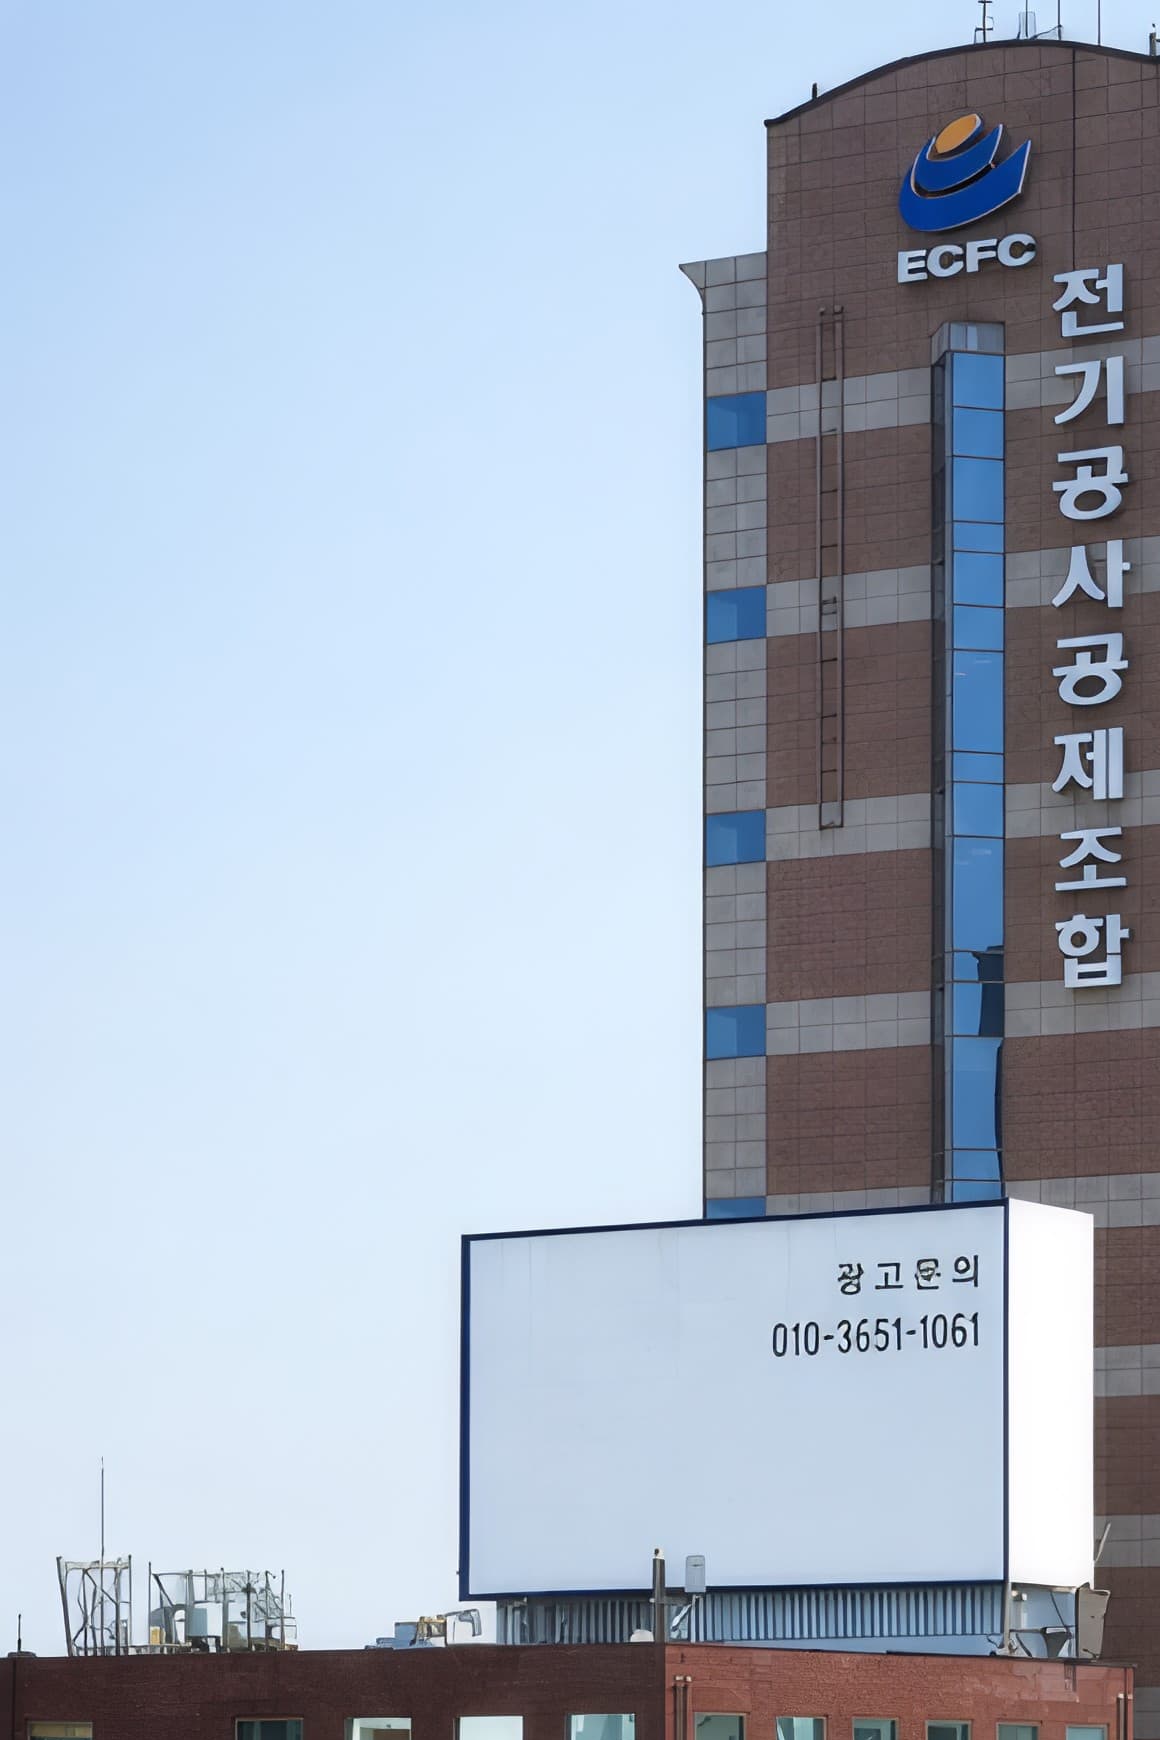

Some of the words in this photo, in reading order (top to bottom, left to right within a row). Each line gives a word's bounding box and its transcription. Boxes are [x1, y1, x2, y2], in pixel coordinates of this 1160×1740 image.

[897, 233, 1037, 284] ECFC
[1051, 263, 1130, 989] 전기공사공제조합
[837, 1254, 979, 1296] 광고문의
[771, 1311, 980, 1358] 010-3651-1061
